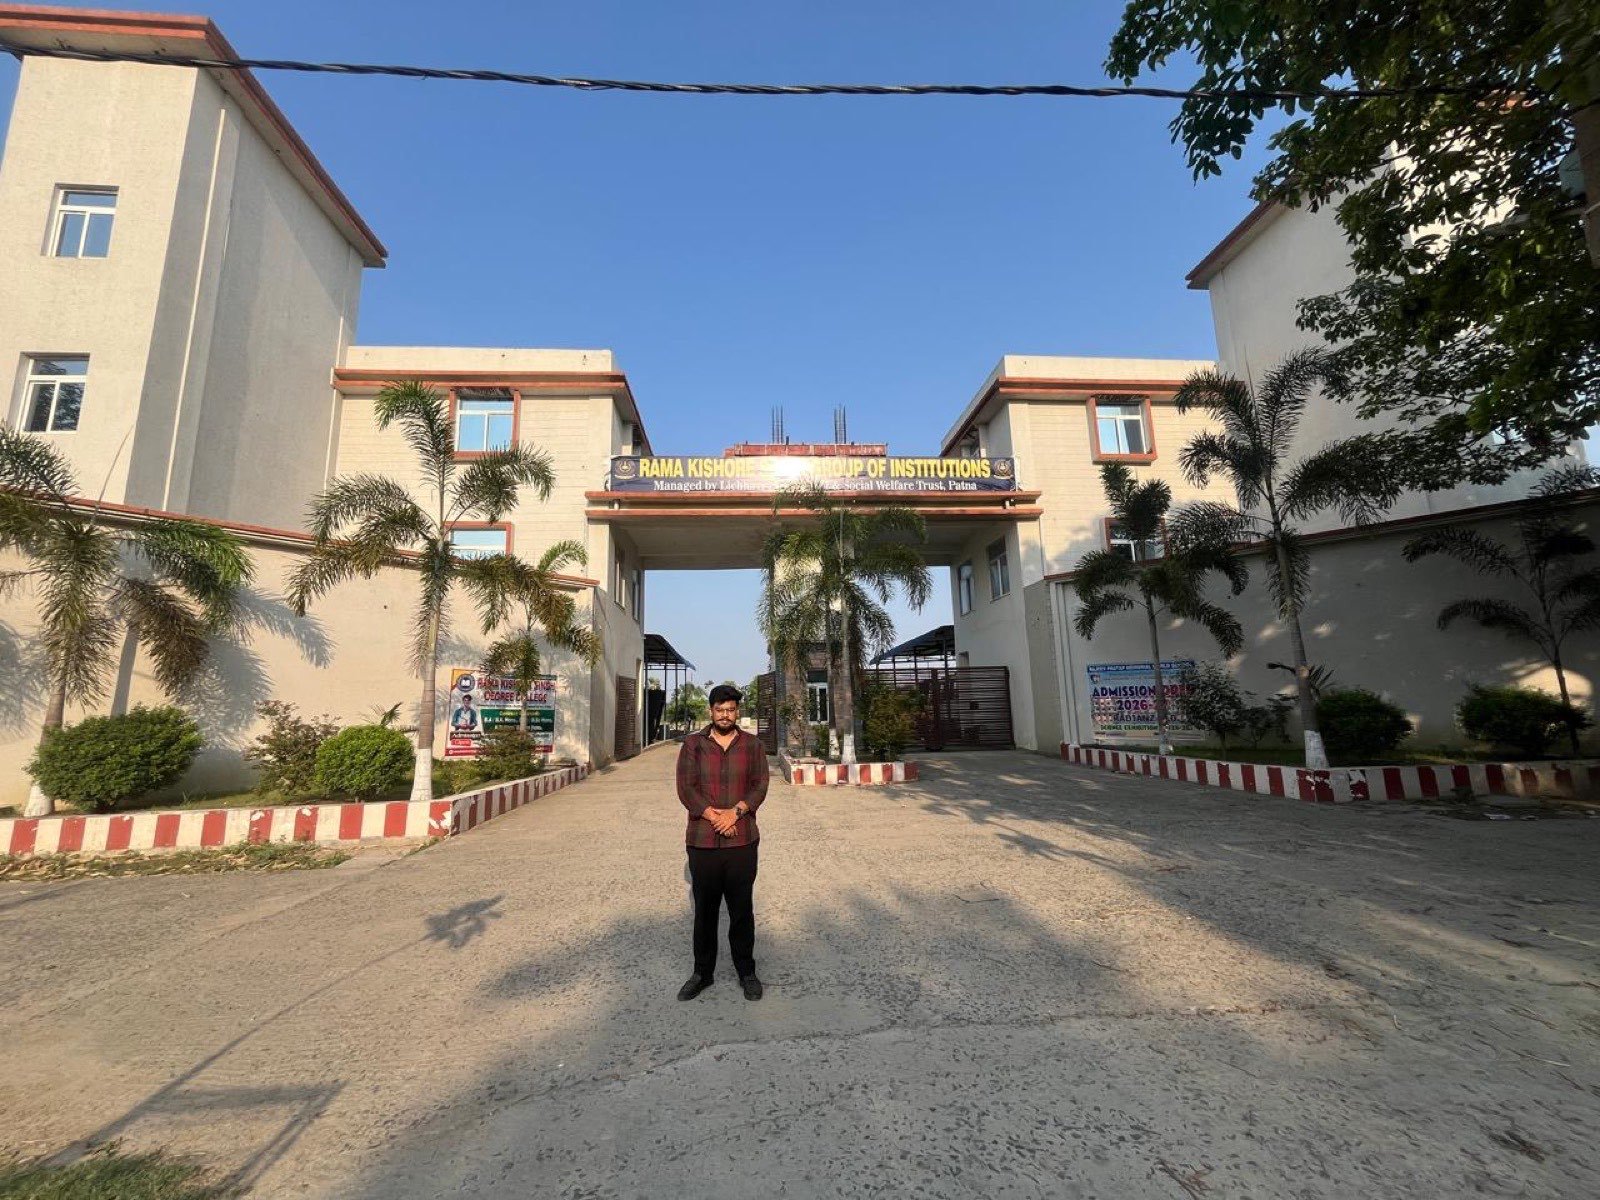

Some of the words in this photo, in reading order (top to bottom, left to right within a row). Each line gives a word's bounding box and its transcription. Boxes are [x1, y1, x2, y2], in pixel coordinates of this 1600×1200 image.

[639, 458, 683, 478] RAMA
[868, 458, 886, 478] OF
[890, 458, 991, 479] INSTITUTIONS
[653, 480, 702, 492] Managed
[706, 480, 718, 492] by
[845, 480, 873, 491] Social
[876, 480, 914, 491] Welfare
[915, 480, 946, 492] Trust,
[948, 480, 977, 491] Patna
[484, 690, 515, 701] DEGREE
[516, 691, 548, 703] CLLEGE
[1093, 685, 1156, 697] ADMISSION
[1117, 699, 1168, 711] 2026-
